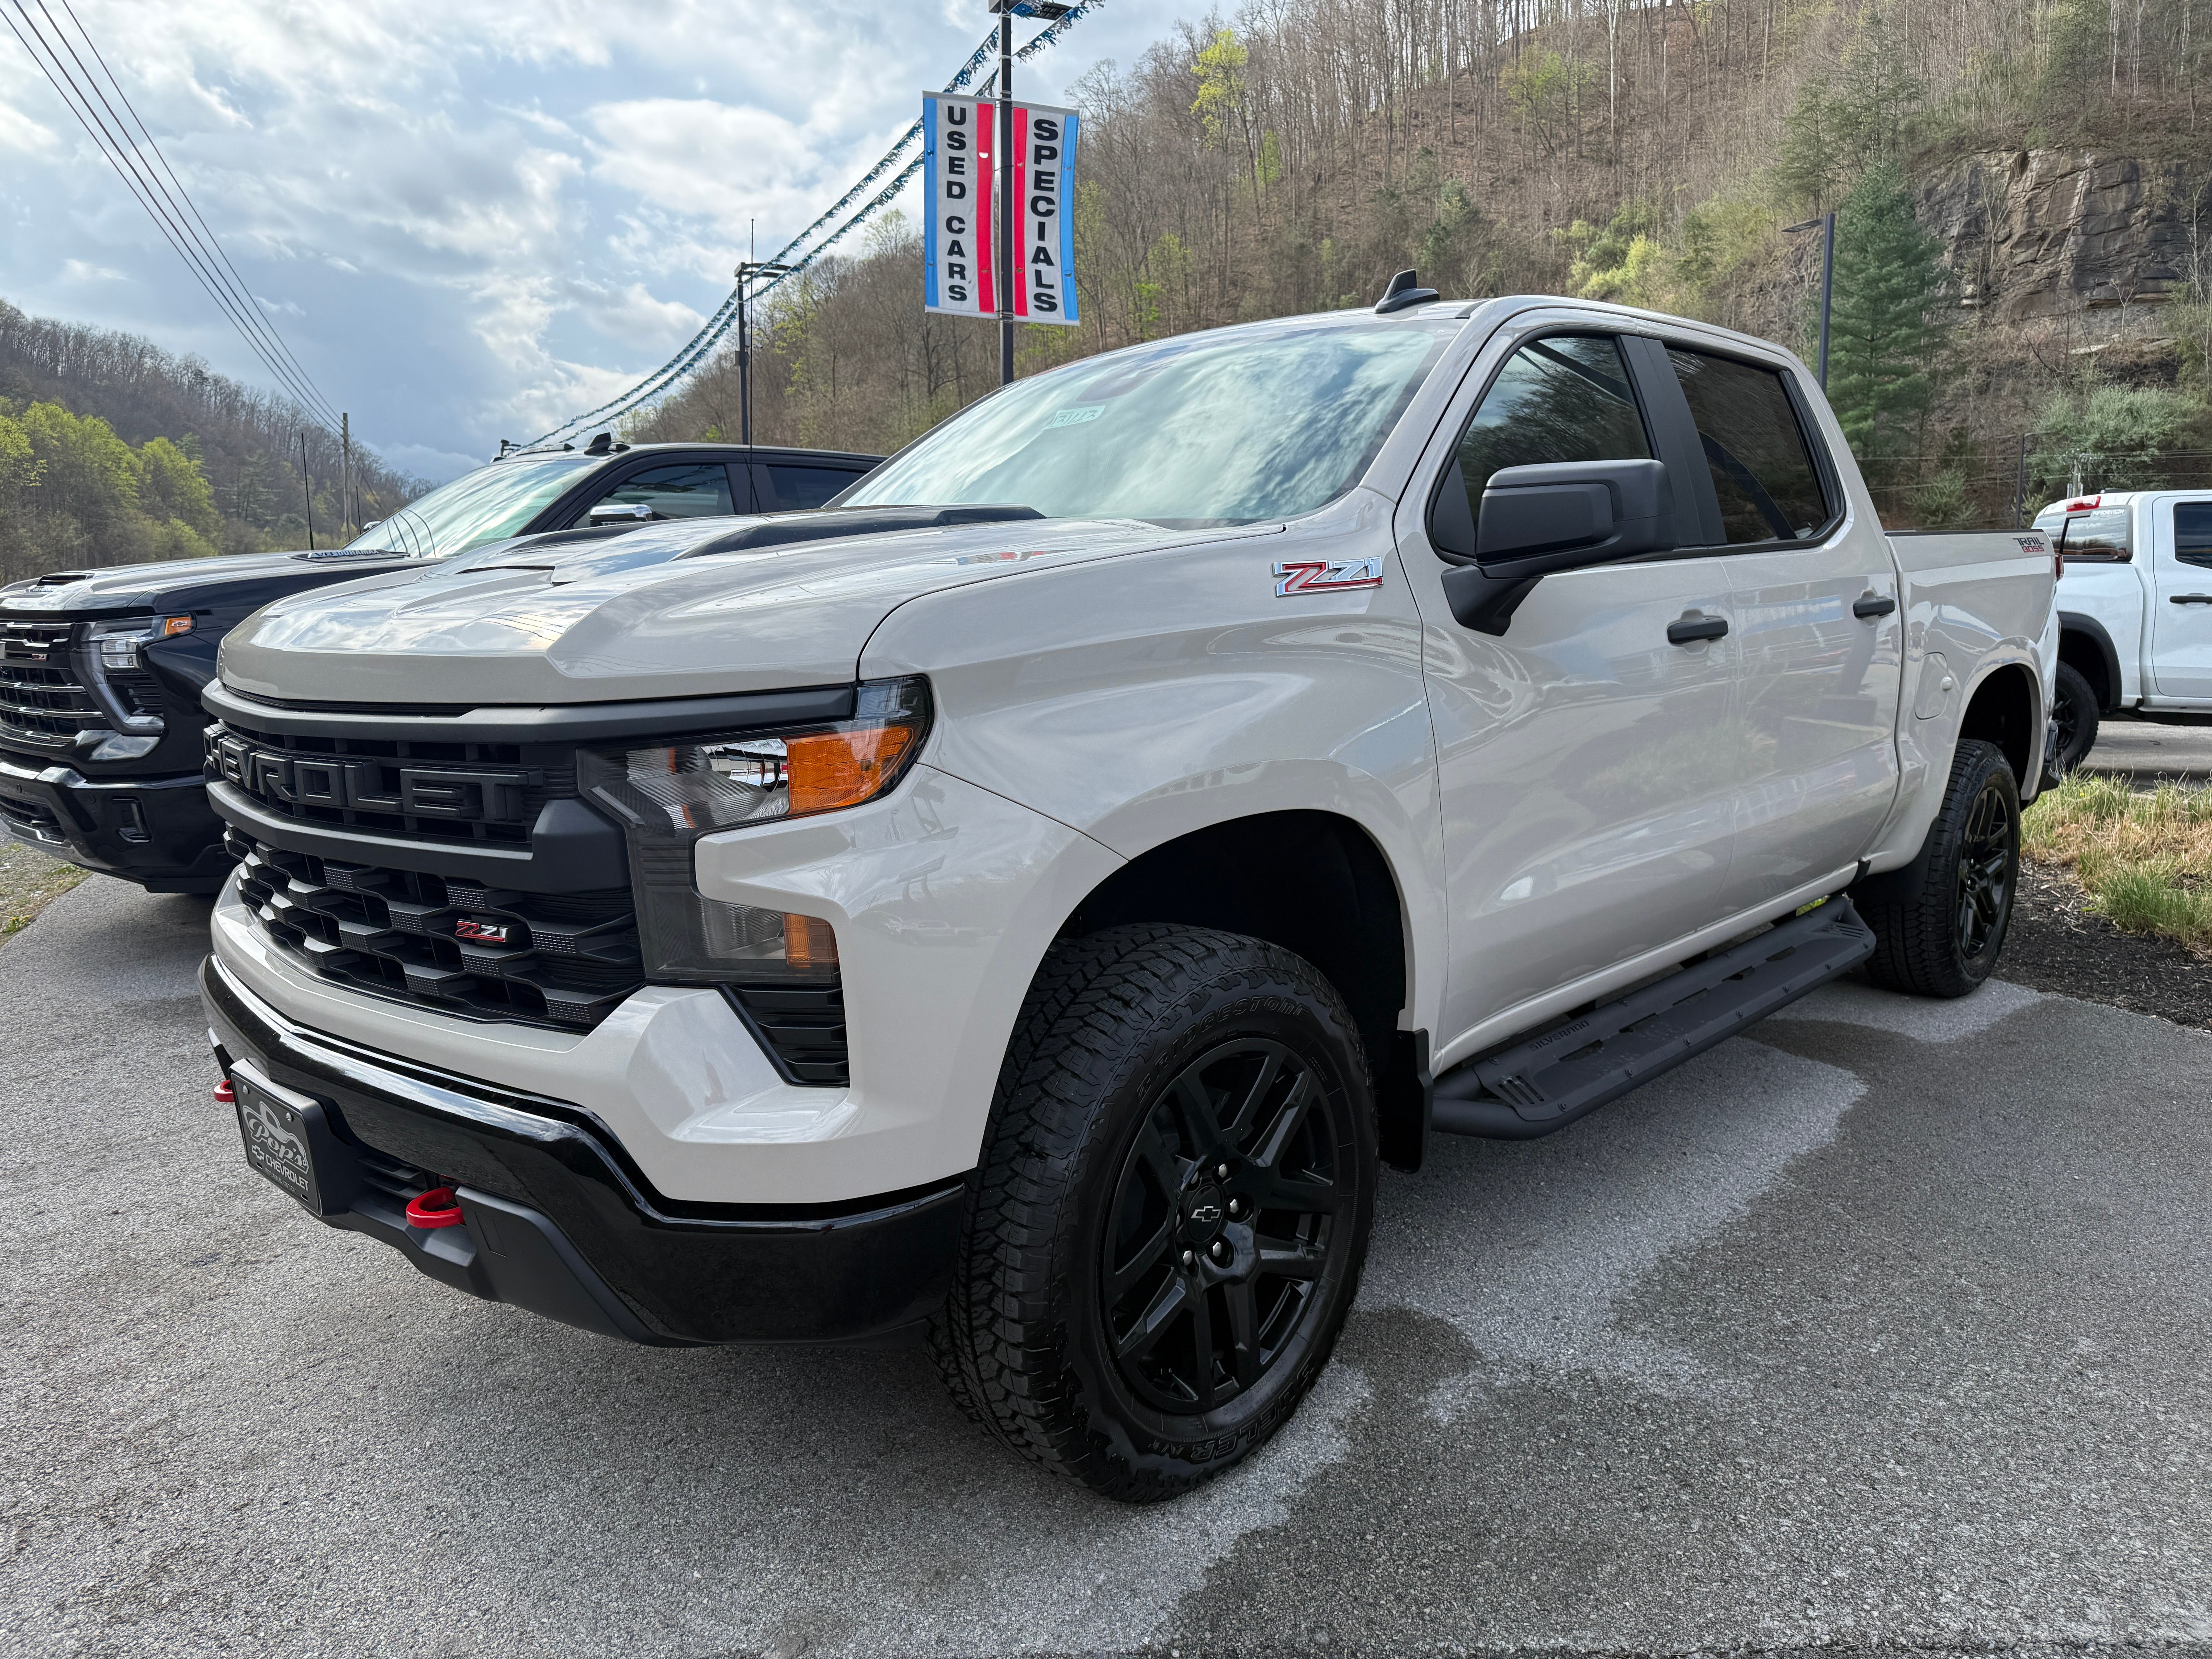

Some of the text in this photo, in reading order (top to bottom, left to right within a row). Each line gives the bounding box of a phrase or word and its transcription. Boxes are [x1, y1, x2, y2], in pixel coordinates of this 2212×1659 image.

[946, 105, 967, 302] USED CARS
[1030, 118, 1058, 312] SPECIALS
[2013, 537, 2044, 546] TRAIL
[2021, 545, 2044, 553] BOSS
[1271, 556, 1384, 598] Z71
[455, 920, 508, 943] Z71
[1136, 994, 1312, 1105] BRIDGESTONE
[1529, 1020, 1590, 1051] SILVERADO
[266, 1154, 309, 1192] CHEVROLET
